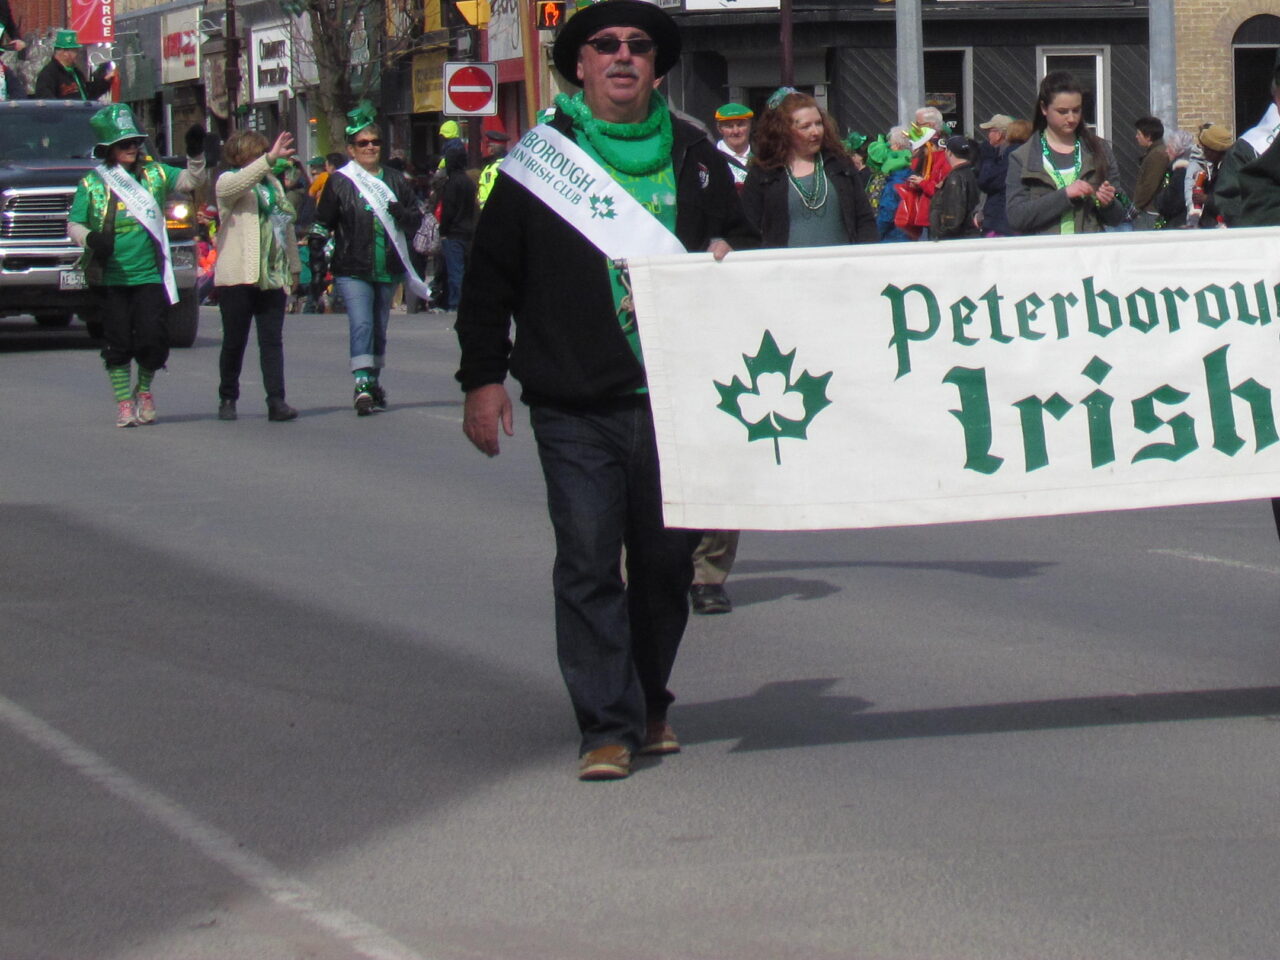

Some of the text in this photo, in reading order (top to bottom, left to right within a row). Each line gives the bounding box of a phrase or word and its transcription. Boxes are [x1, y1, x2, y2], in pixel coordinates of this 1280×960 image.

[524, 156, 552, 184] IRISH
[553, 179, 584, 206] CLUB
[942, 344, 1280, 476] Irish
